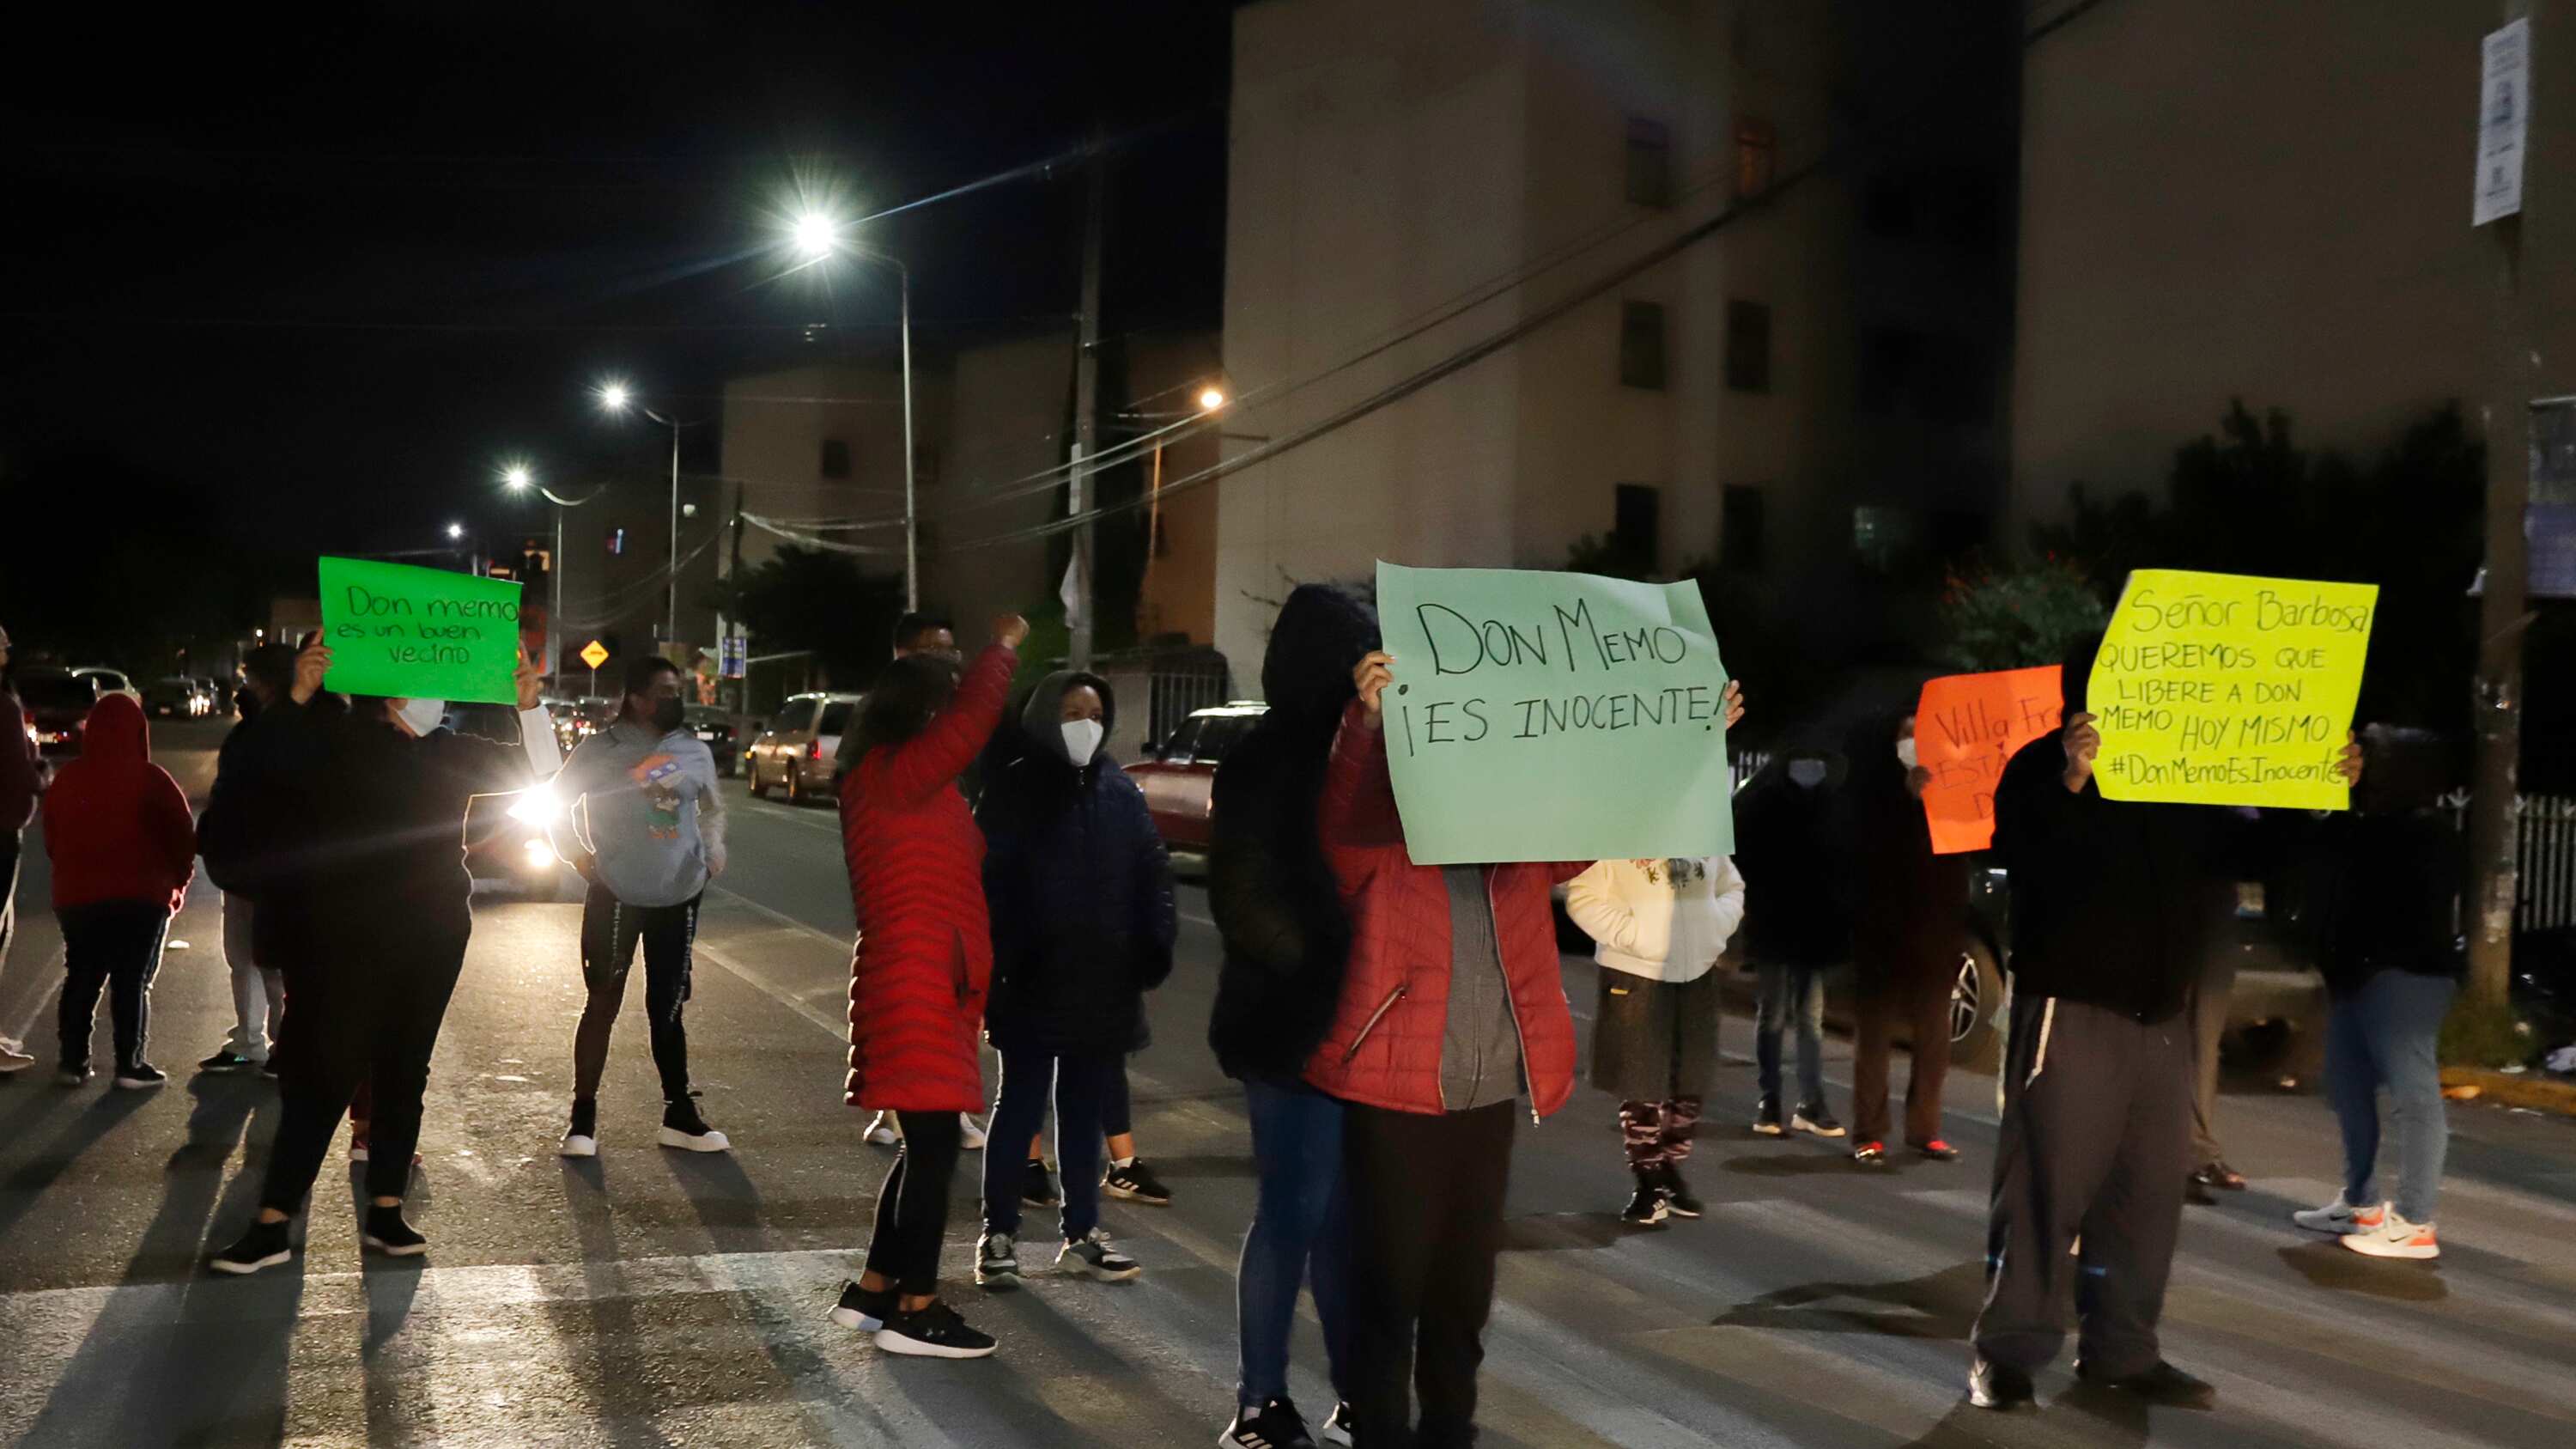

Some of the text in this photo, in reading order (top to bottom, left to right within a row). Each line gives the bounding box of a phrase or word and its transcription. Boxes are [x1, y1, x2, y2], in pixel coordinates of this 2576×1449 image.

[347, 586, 519, 622] Don memo
[2131, 589, 2368, 633] Señor Barbosa
[337, 622, 481, 640] es un buen
[1417, 598, 1686, 674] DON MEMO
[389, 643, 469, 664] vecino
[2098, 642, 2326, 673] QUEREMOS QUE
[2118, 679, 2302, 705] LIBERE A DON
[1398, 682, 1728, 757] ¡ES INOCENTE!
[1935, 697, 2010, 750] Villa
[2102, 704, 2330, 752] MEMO HOY MISMO
